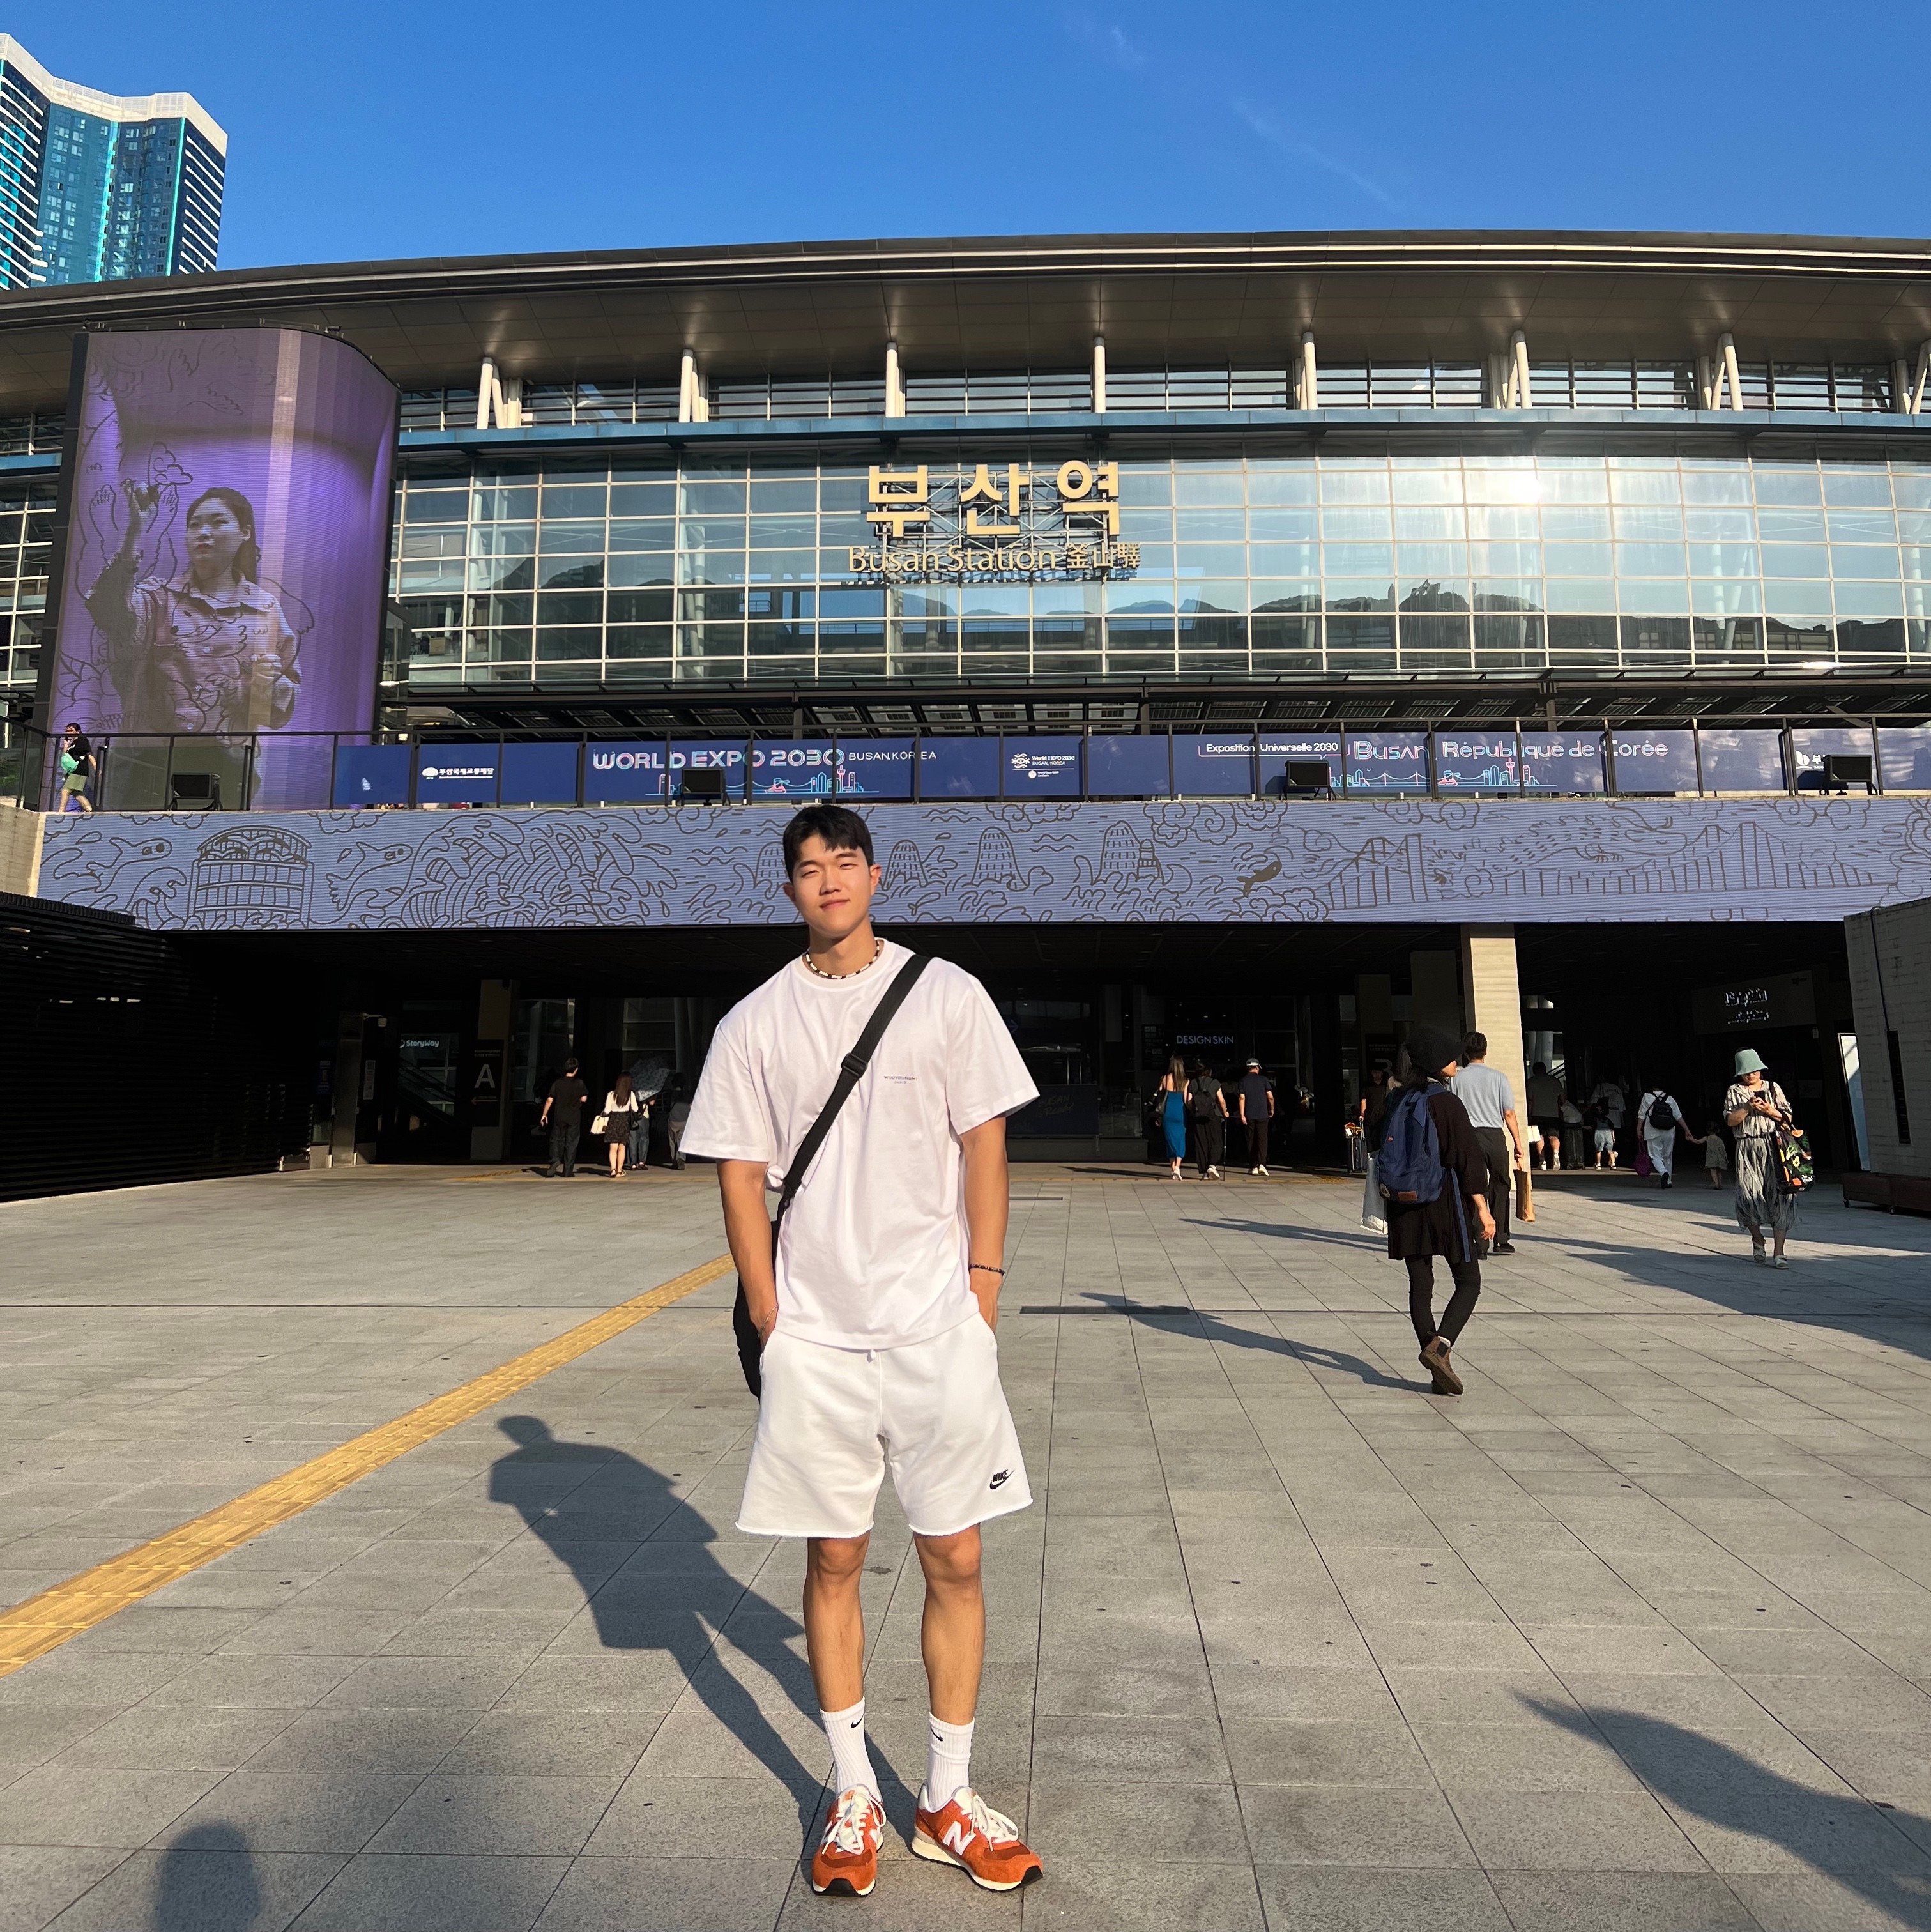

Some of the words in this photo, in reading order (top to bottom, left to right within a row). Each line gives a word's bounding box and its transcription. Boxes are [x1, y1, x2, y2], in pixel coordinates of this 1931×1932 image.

[866, 459, 1120, 538] 부산역
[848, 545, 940, 572] Busan
[947, 544, 1056, 571] Station
[1067, 542, 1140, 569] 釜山驛
[592, 749, 687, 769] WORLD
[691, 750, 765, 768] EXPO
[770, 749, 845, 767] 2030
[1206, 744, 1255, 754] Exposition
[1260, 743, 1313, 752] Universelle
[1313, 742, 1338, 751] 2030
[1568, 740, 1595, 757] de
[474, 1063, 496, 1089] A
[993, 1469, 1008, 1482] NIKE
[942, 1820, 977, 1856] N
